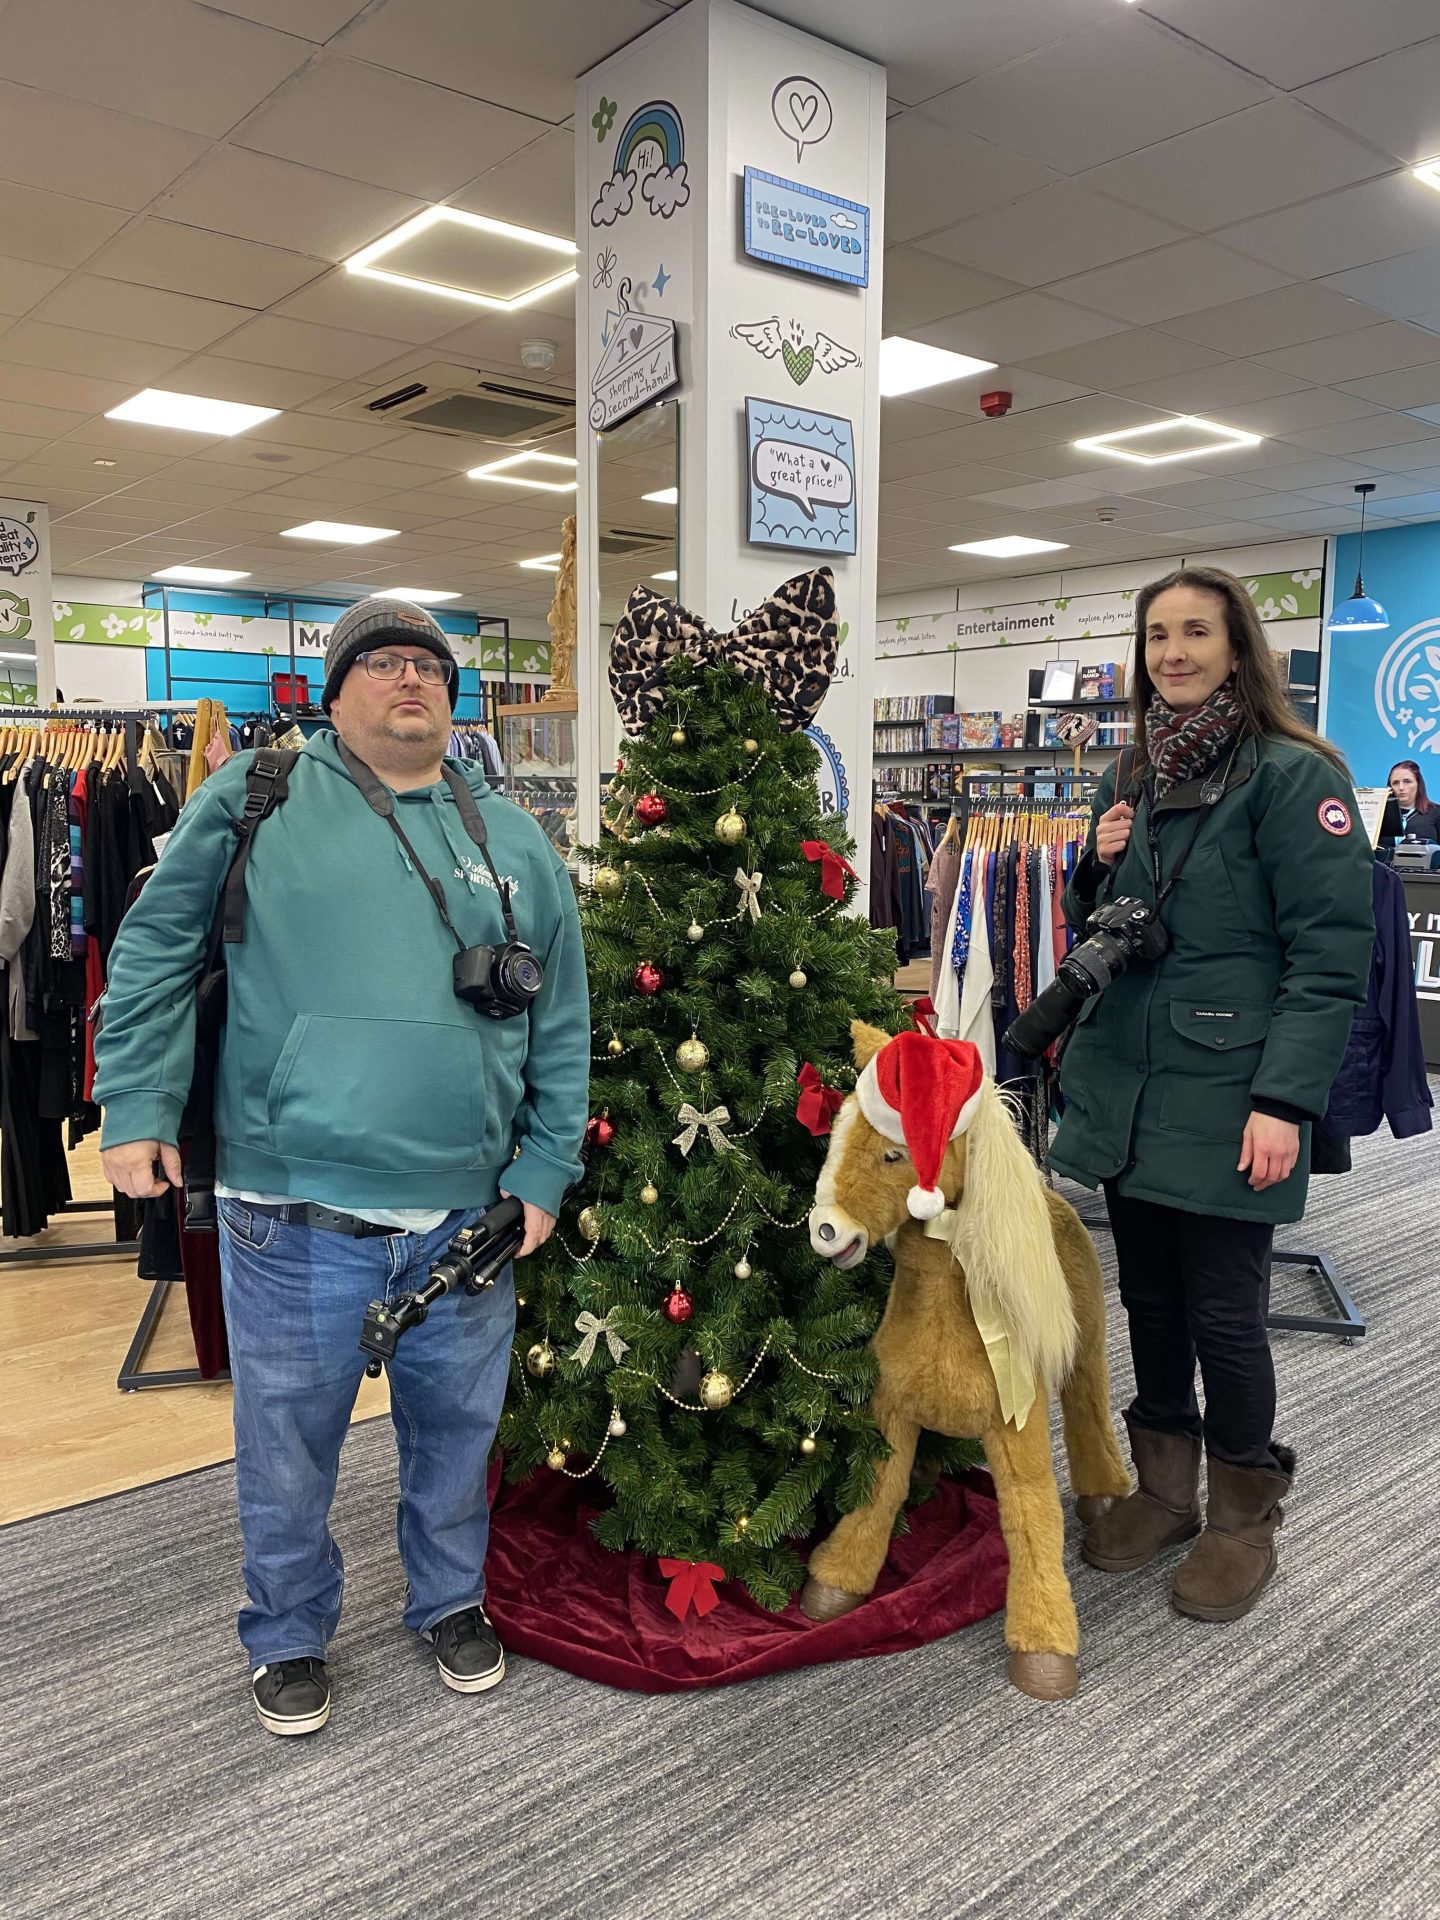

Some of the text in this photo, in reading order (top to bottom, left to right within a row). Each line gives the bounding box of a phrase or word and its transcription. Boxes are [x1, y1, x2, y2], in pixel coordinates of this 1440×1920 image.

[637, 146, 655, 169] Hi!
[755, 200, 828, 230] PRE-LOVED
[771, 217, 862, 256] RE-LOVED
[616, 338, 629, 363] I
[608, 361, 672, 418] second-hand!
[609, 367, 645, 400] shopping
[808, 460, 815, 470] a
[770, 468, 802, 488] great
[0, 528, 19, 541] eat
[0, 552, 28, 564] tems
[956, 613, 1056, 637] Entertainment
